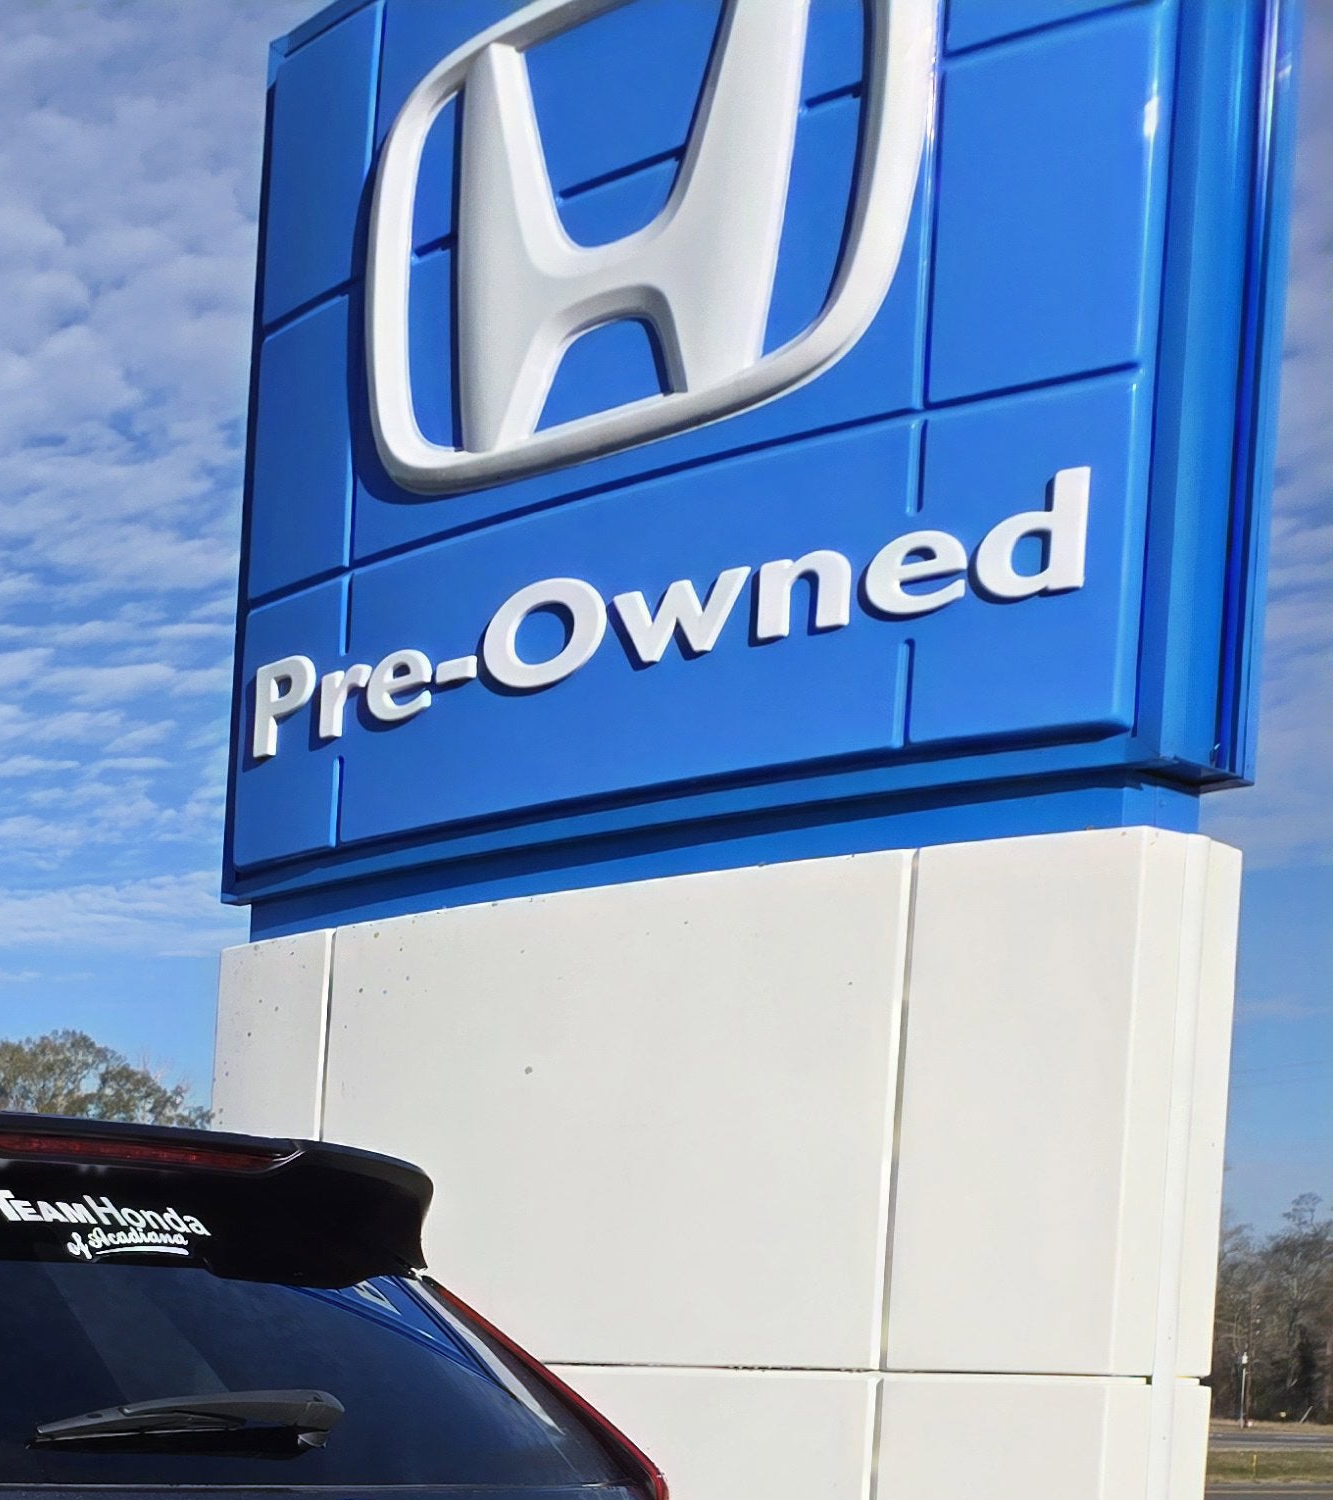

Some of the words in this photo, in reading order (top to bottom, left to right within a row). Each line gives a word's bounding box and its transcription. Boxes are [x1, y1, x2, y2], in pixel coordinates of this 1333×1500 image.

[251, 465, 1093, 758] Pre-Owned
[83, 1194, 212, 1237] Honda
[66, 1231, 93, 1260] of
[88, 1226, 189, 1248] Acadiana
